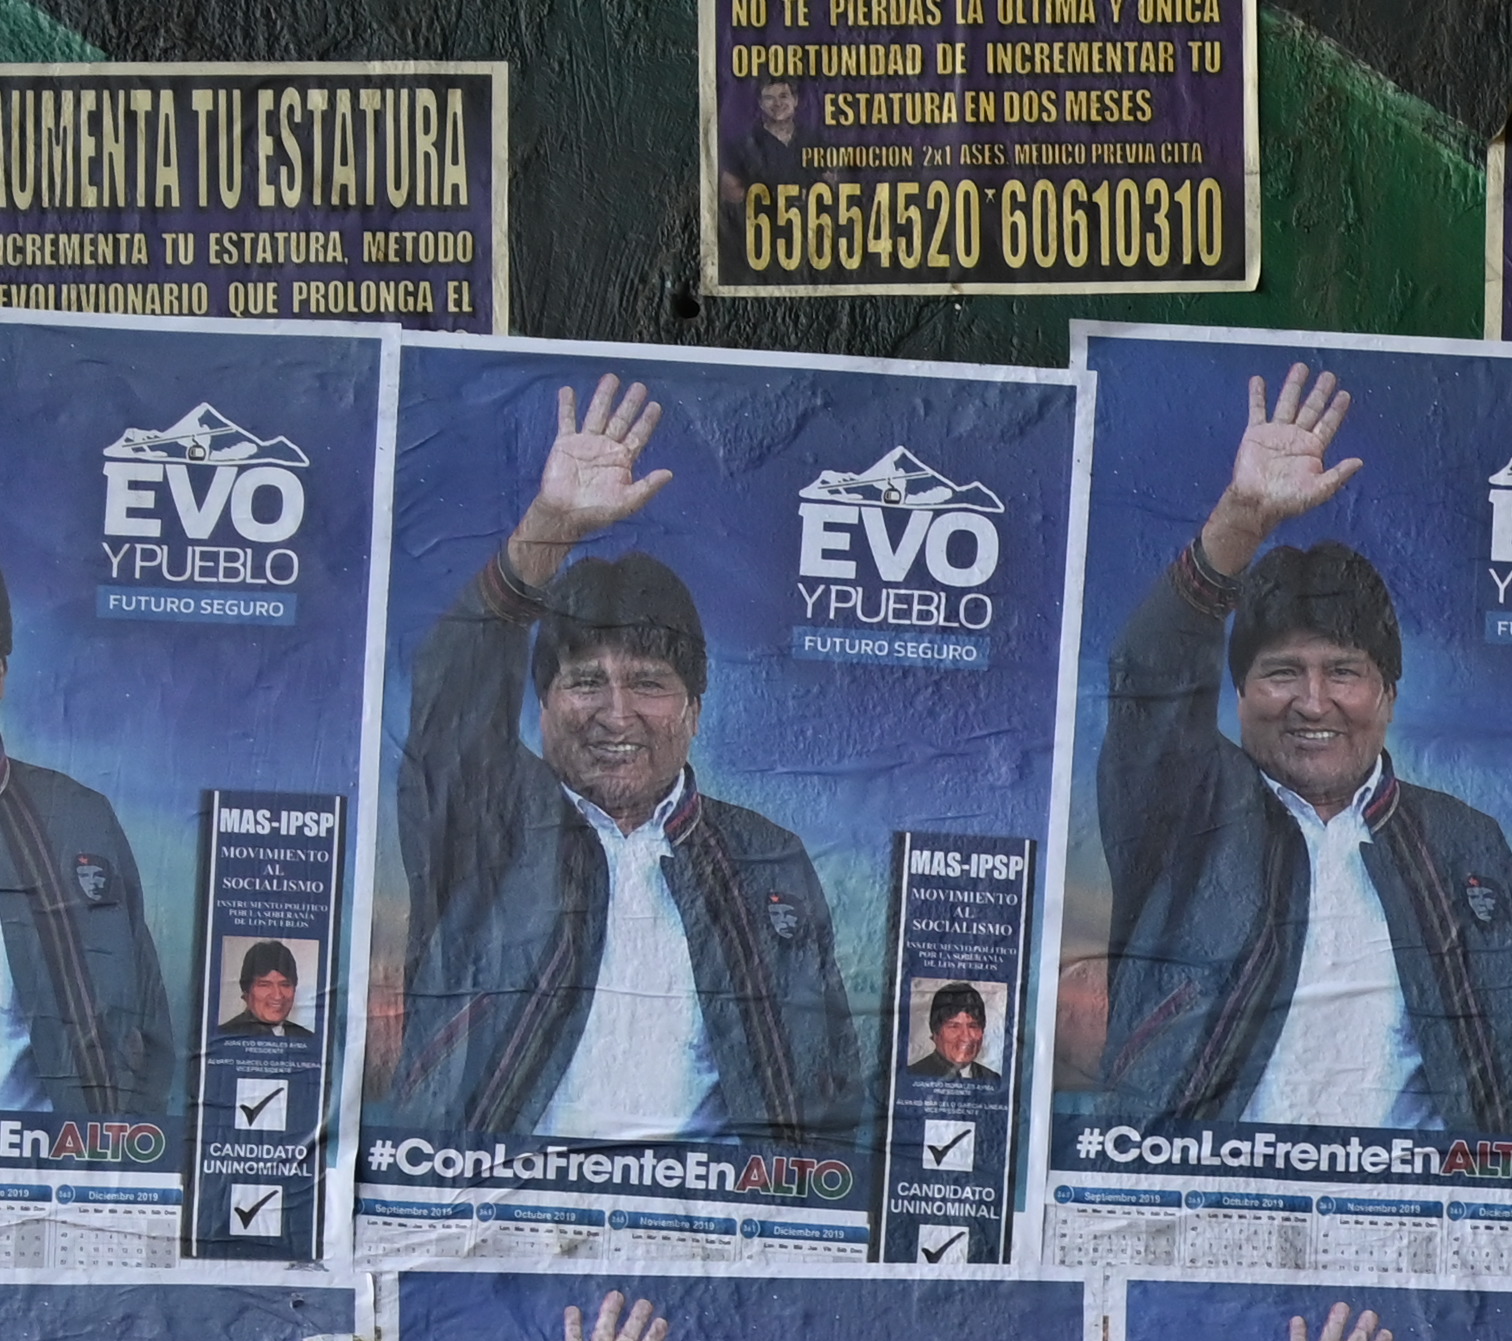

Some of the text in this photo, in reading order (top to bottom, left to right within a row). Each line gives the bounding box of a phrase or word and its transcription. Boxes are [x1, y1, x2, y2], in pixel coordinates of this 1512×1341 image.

[732, 41, 1222, 77] OPORTUNIDAD DE INCREMENTAR TU
[824, 90, 1153, 126] ESTATURA EN DOS MESES
[0, 87, 468, 209] UMENTA TU ESTATURA
[1014, 143, 1086, 165] MEDICO
[1092, 144, 1155, 164] PREVIA
[1160, 143, 1203, 164] CITA
[745, 178, 1222, 271] 65654520 60610310
[103, 462, 304, 543] EVO
[798, 502, 999, 587] EVO
[369, 1133, 852, 1198] #ConLaFrenteEnALTO
